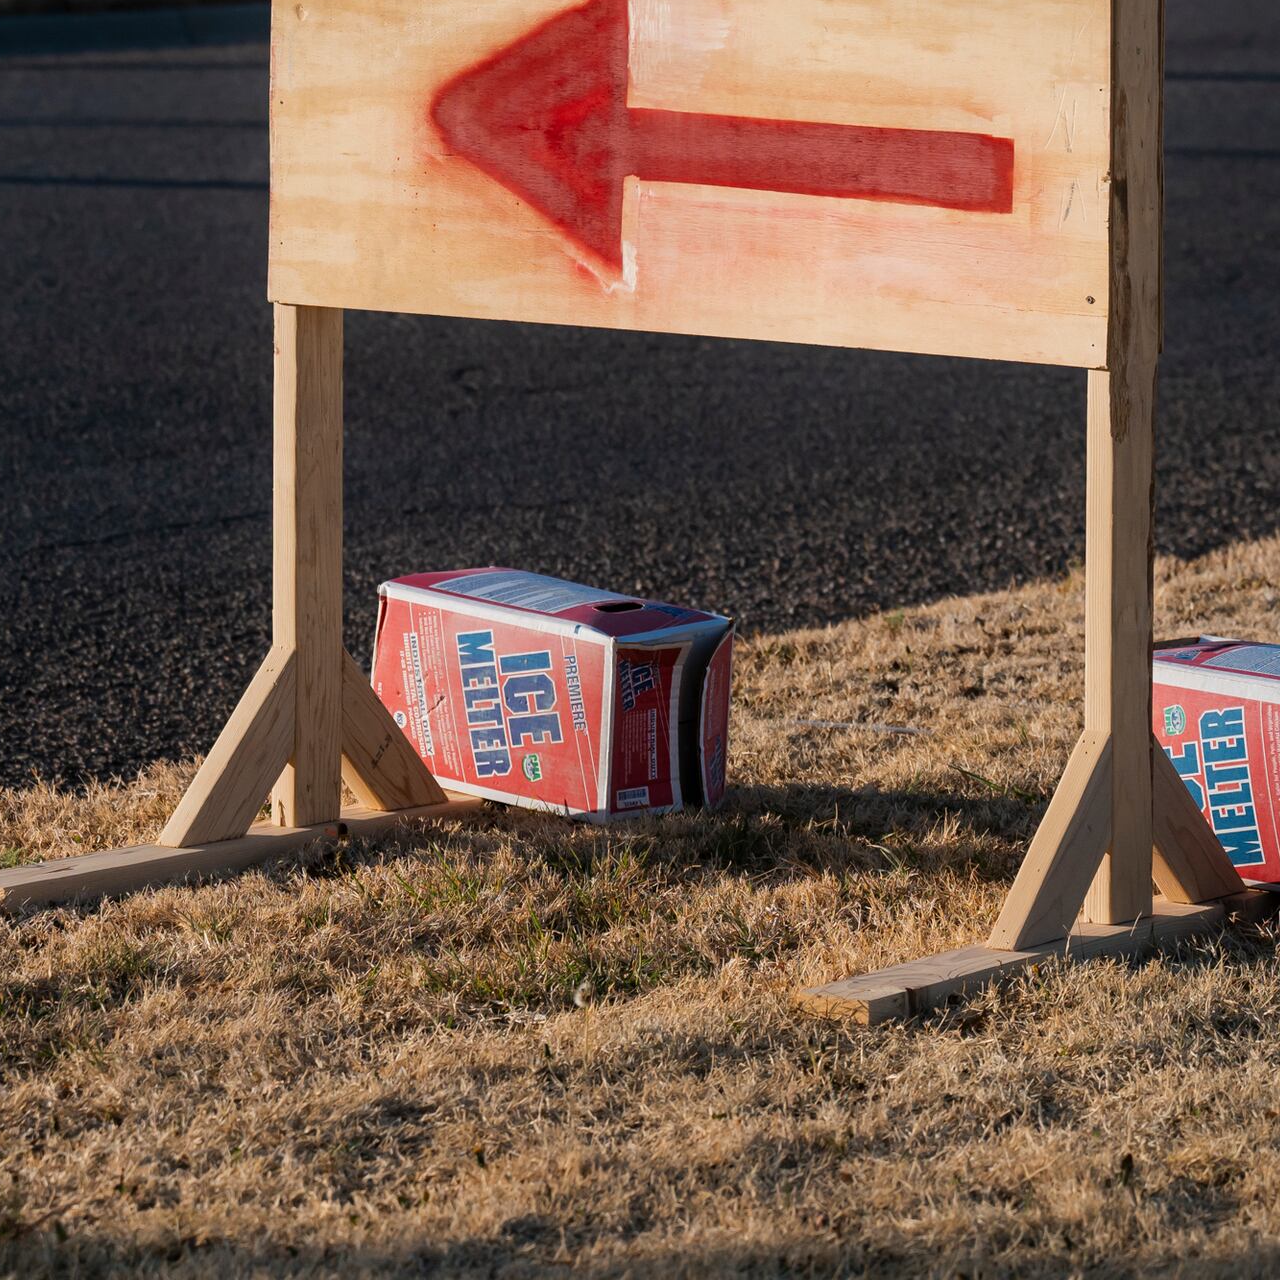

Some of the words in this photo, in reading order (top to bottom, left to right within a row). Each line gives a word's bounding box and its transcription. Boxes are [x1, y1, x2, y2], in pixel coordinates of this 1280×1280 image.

[414, 706, 427, 758] CORROSION
[422, 720, 433, 754] DUTY
[455, 629, 512, 779] MELTER
[498, 650, 564, 749] ICE
[564, 655, 587, 732] PREMIERE
[1199, 706, 1266, 867] MELTER
